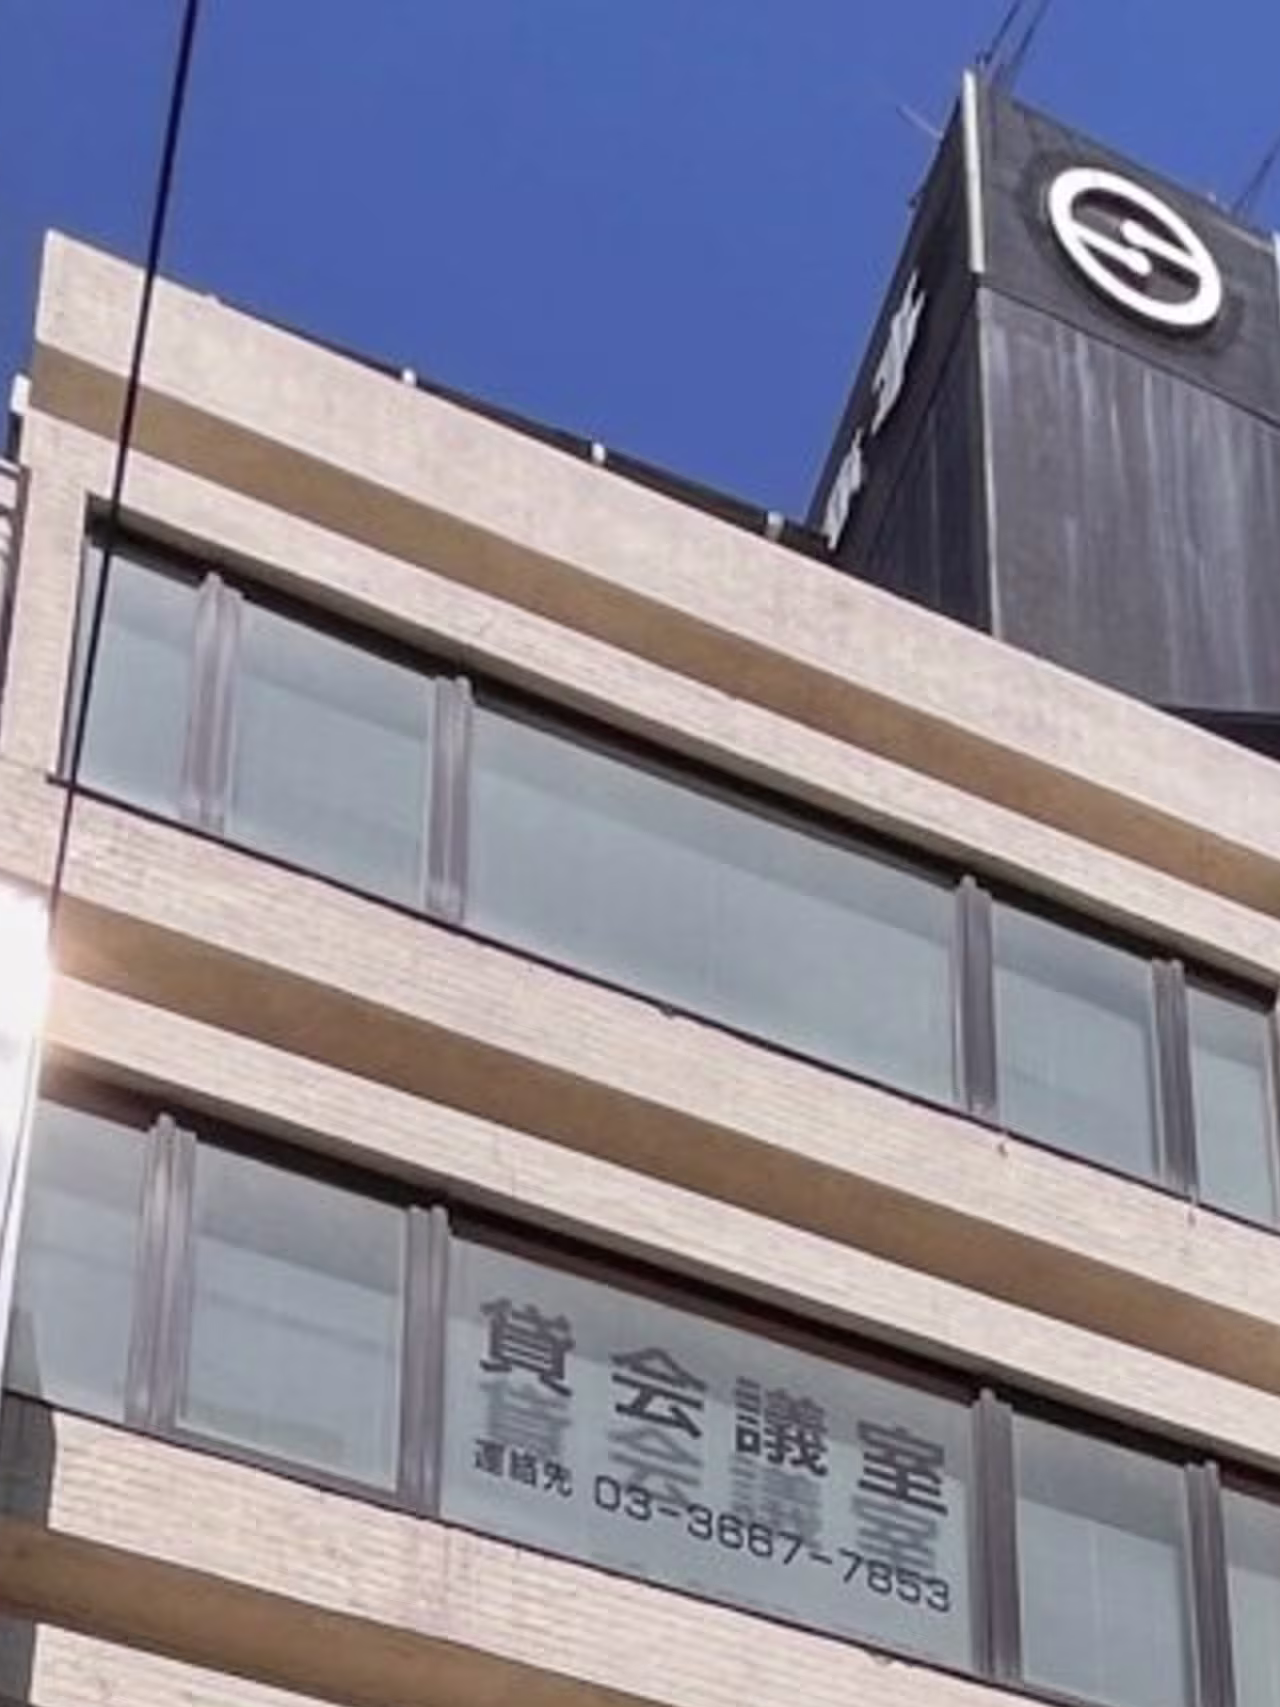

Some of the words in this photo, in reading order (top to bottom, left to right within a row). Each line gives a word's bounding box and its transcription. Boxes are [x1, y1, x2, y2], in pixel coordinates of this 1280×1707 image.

[479, 1298, 949, 1517] 貸会議室
[475, 1438, 574, 1498] 連絡先
[595, 1475, 951, 1613] 03-3667-7853
